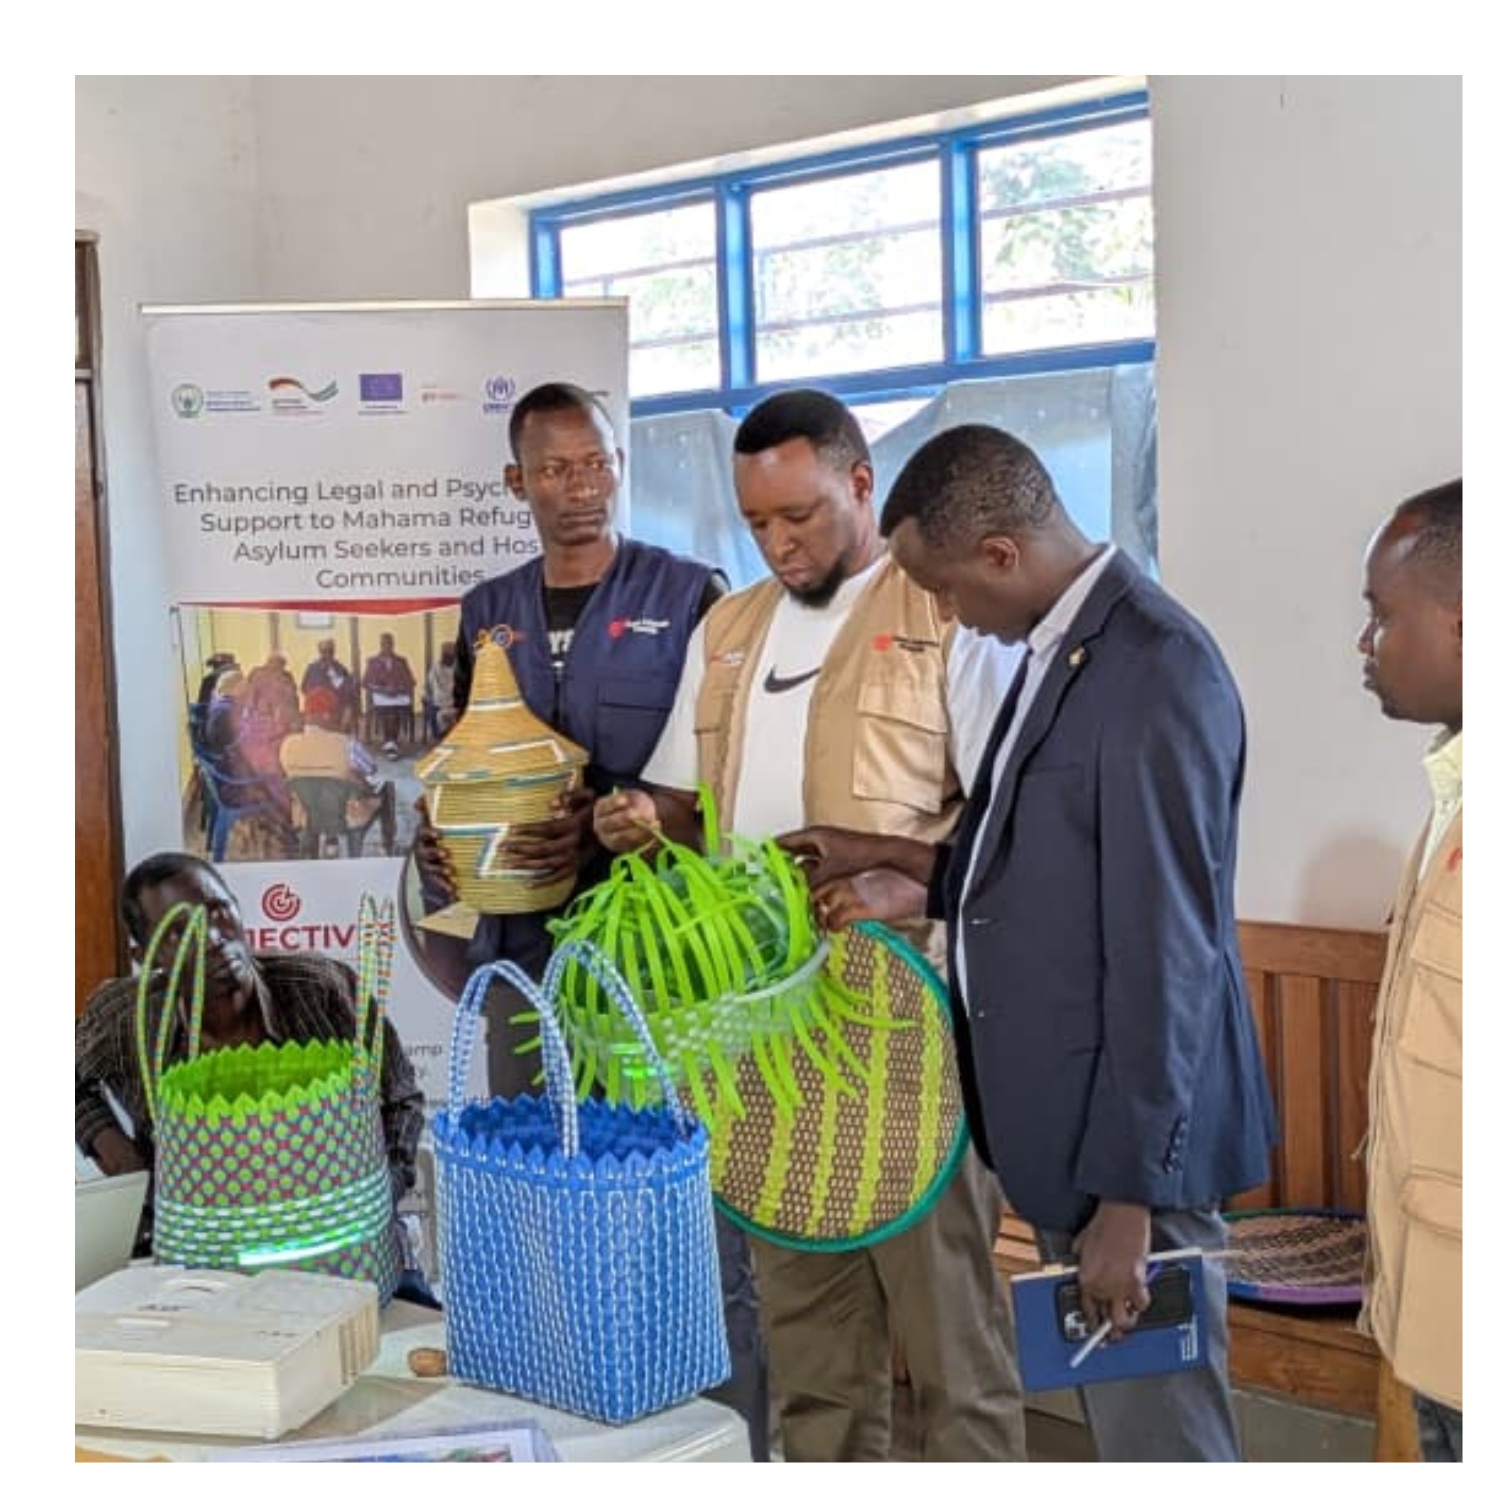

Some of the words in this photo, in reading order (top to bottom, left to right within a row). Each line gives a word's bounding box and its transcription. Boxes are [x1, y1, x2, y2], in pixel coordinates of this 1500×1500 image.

[174, 482, 308, 504] Enhancing
[318, 480, 383, 504] Legal
[392, 479, 438, 498] and
[201, 512, 303, 535] Support
[311, 513, 335, 530] to
[343, 510, 450, 528] Mahama
[460, 507, 532, 529] Refug
[233, 540, 327, 565] Asylum
[335, 538, 432, 559] Seekers
[439, 536, 485, 556] and
[493, 536, 538, 554] Hos
[316, 565, 483, 588] Communities
[244, 924, 356, 950] JECTIV
